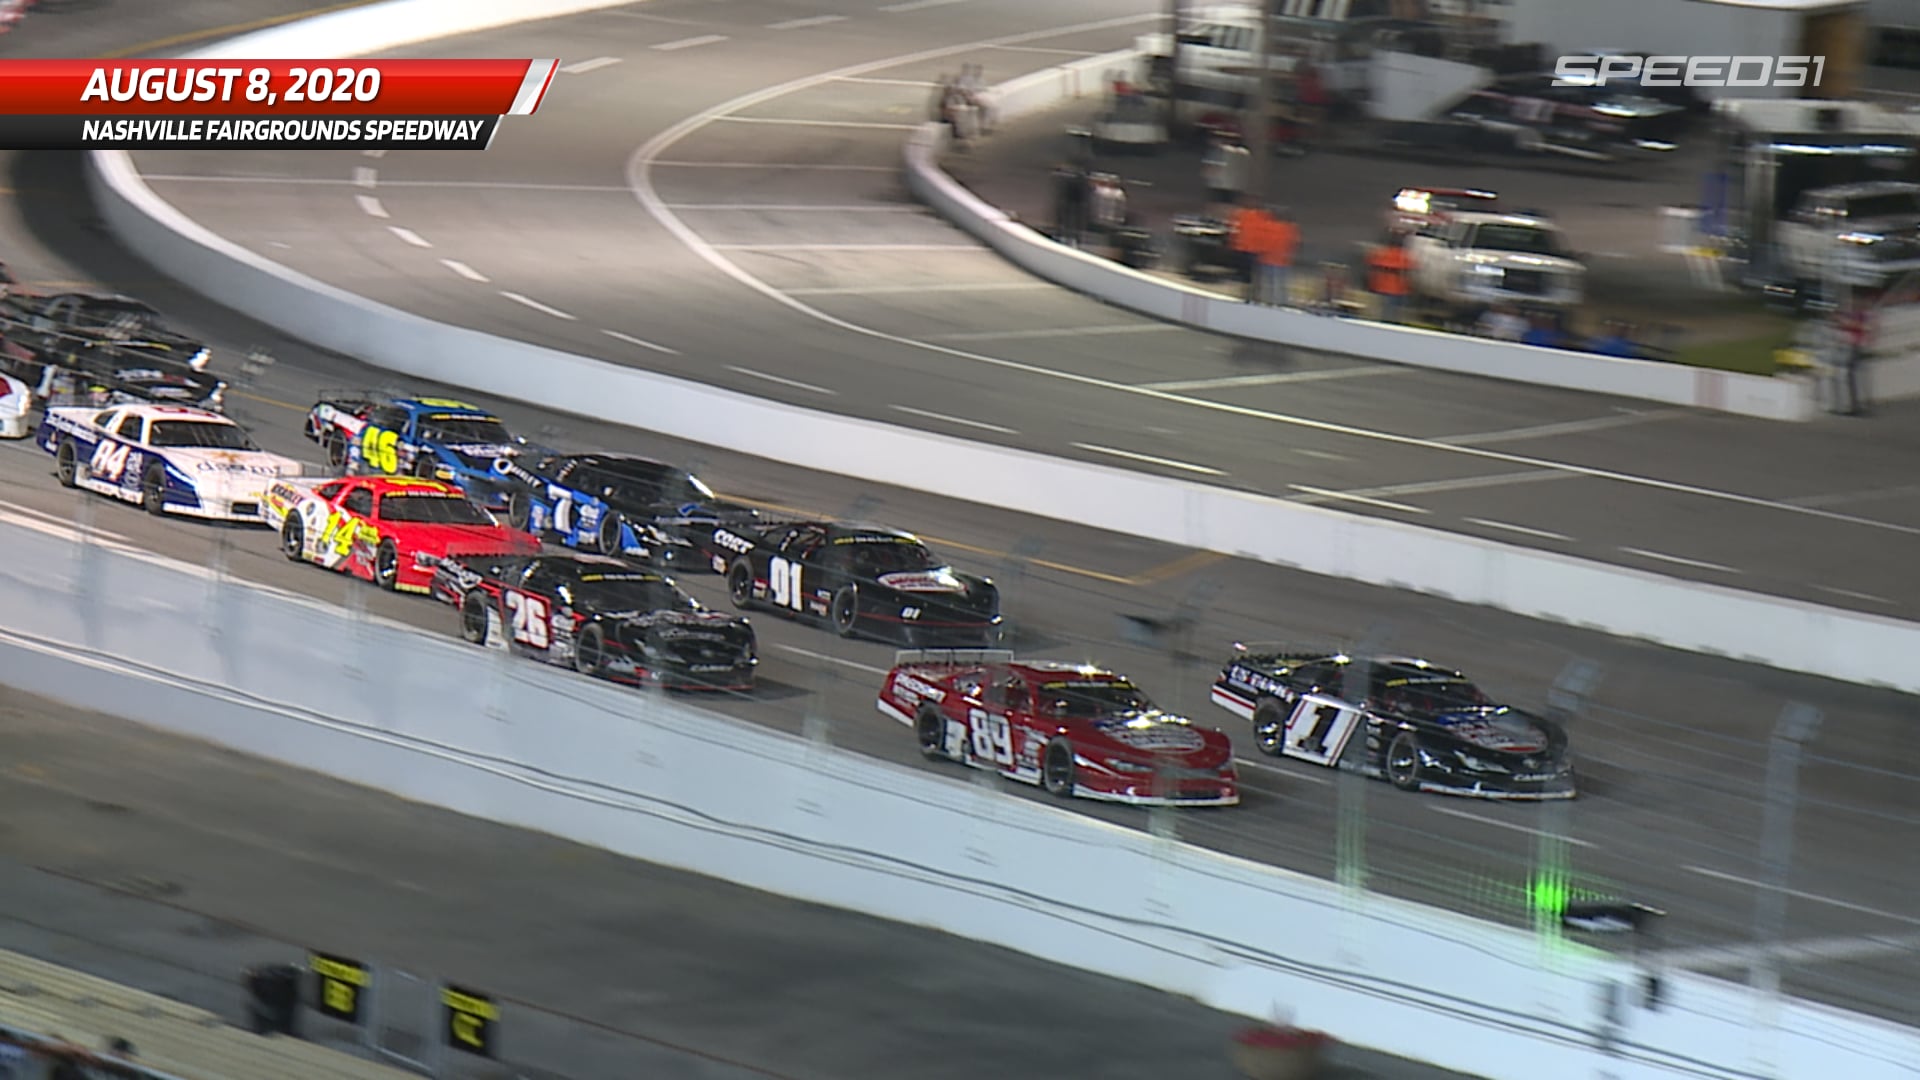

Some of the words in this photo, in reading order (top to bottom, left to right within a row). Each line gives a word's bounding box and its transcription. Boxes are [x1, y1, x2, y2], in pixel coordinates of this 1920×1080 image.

[362, 425, 399, 474] 46
[322, 511, 361, 556] 14
[547, 484, 573, 535] 7
[505, 589, 549, 649] 26
[968, 708, 1015, 767] 89
[1296, 704, 1341, 756] 1
